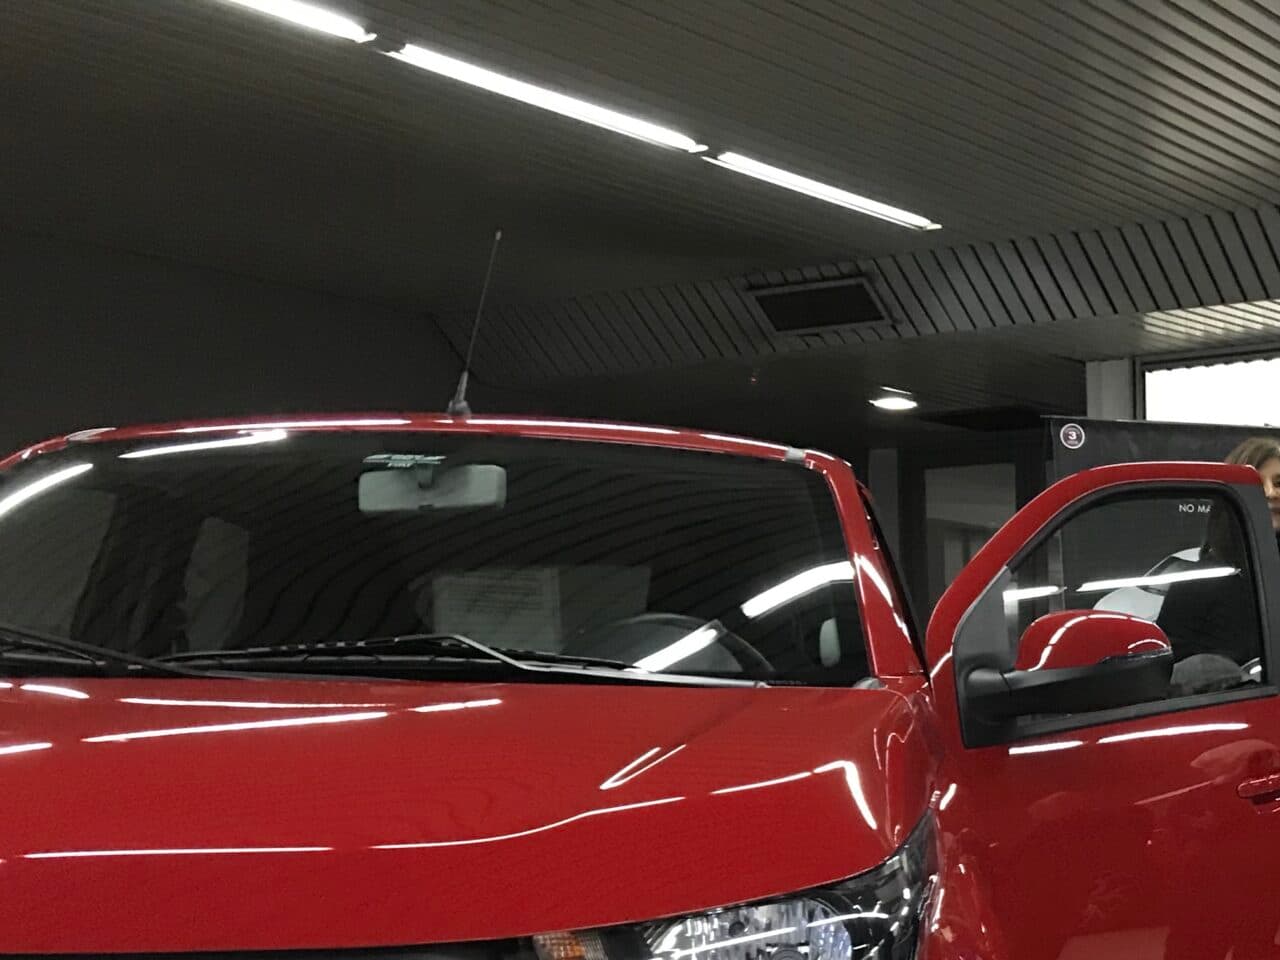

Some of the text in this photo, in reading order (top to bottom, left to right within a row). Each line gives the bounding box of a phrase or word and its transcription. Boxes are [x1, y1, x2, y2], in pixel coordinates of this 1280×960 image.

[1068, 431, 1077, 440] 3
[1178, 504, 1211, 513] NO MA
